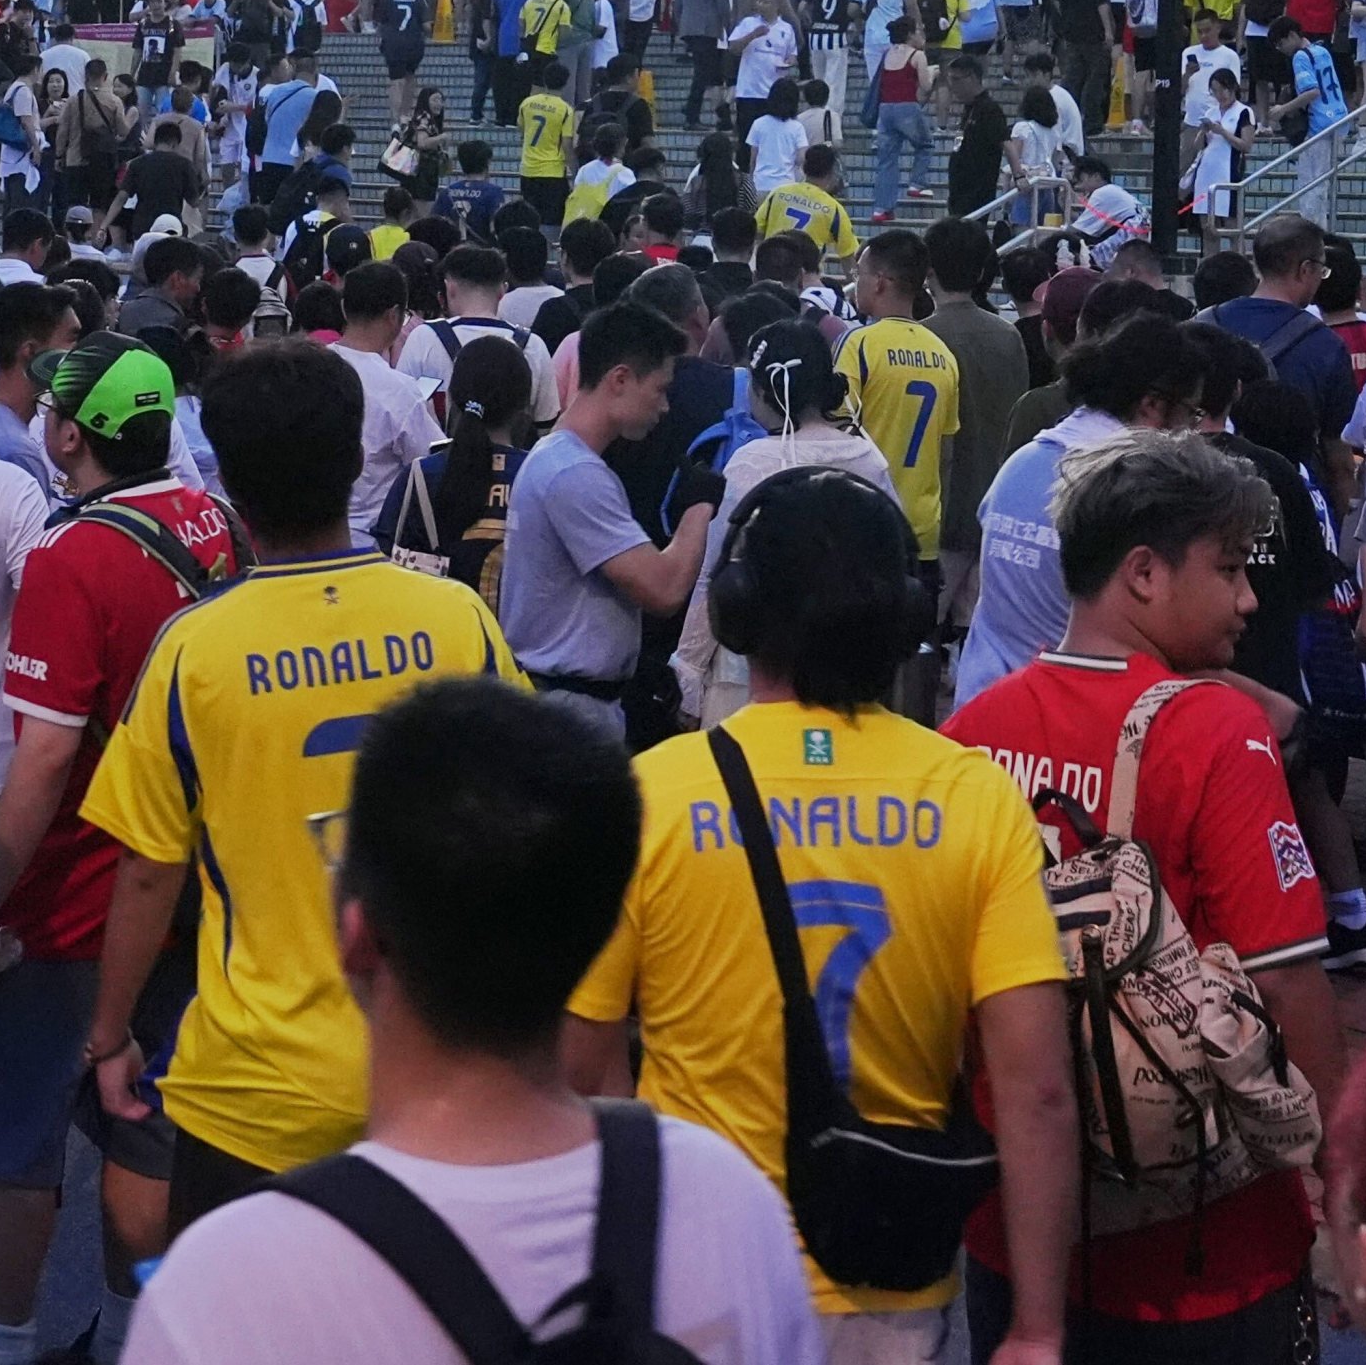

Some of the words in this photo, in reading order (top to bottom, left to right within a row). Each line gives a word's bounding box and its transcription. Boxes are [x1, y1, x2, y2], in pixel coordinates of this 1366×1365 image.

[397, 5, 412, 32] 7
[530, 114, 547, 147] 7
[778, 192, 831, 215] RONALDO
[785, 207, 812, 230] 7
[887, 348, 946, 370] RONALDO
[902, 379, 938, 468] 7
[1246, 554, 1276, 565] ACK
[4, 651, 48, 681] OHLER
[246, 630, 435, 696] RONALDO
[788, 879, 892, 1091] 7
